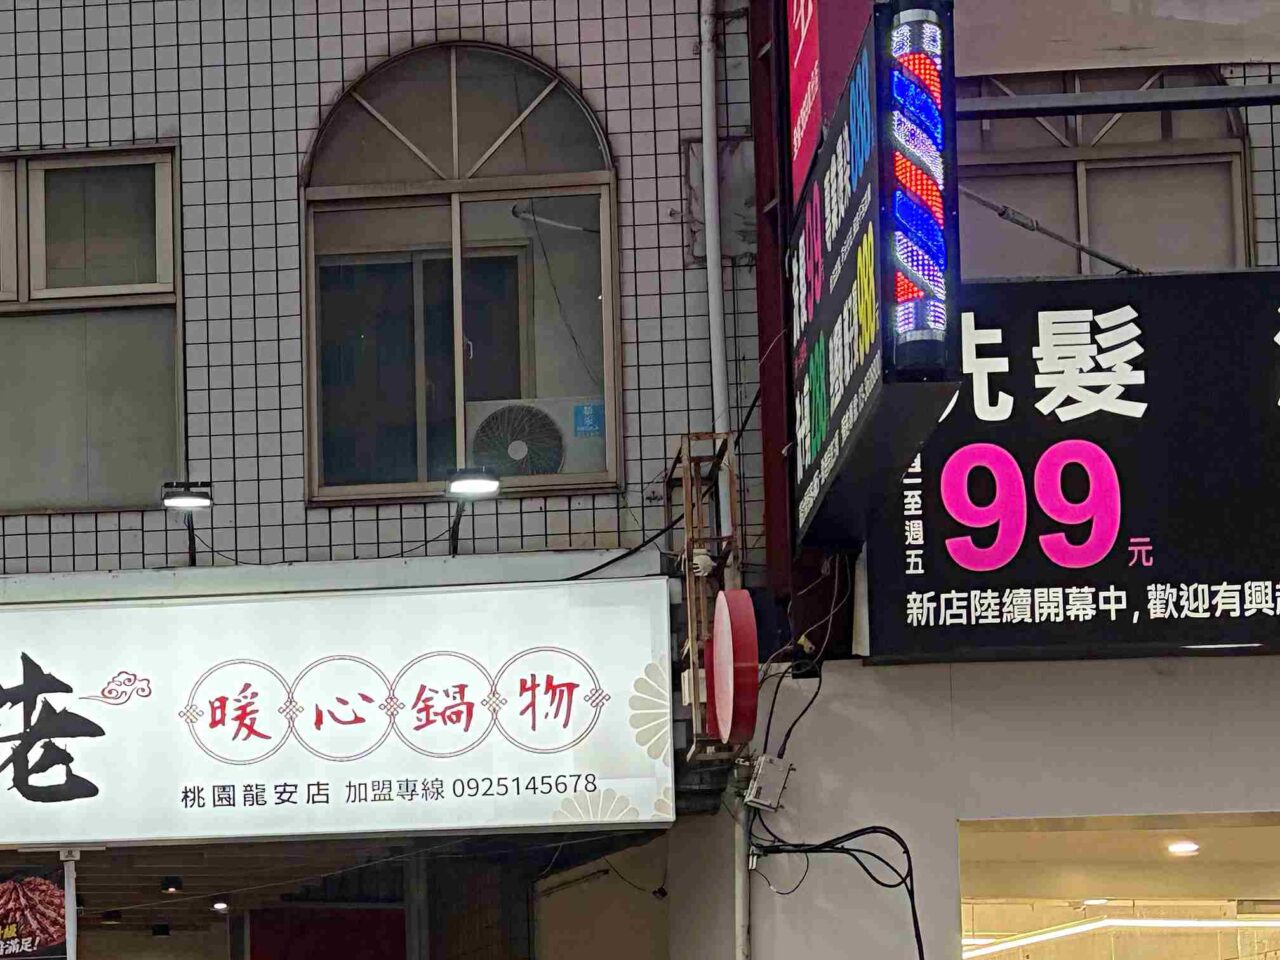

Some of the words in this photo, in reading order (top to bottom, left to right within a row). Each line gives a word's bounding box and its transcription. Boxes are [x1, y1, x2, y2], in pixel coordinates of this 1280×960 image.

[940, 439, 1121, 572] 99
[1127, 537, 1153, 567] 元
[905, 579, 1280, 627] 新店陸續開幕中,歡迎有興
[180, 782, 331, 809] 桃園龍安店
[344, 777, 445, 806] 加盟專線
[451, 771, 598, 798] 0925145678
